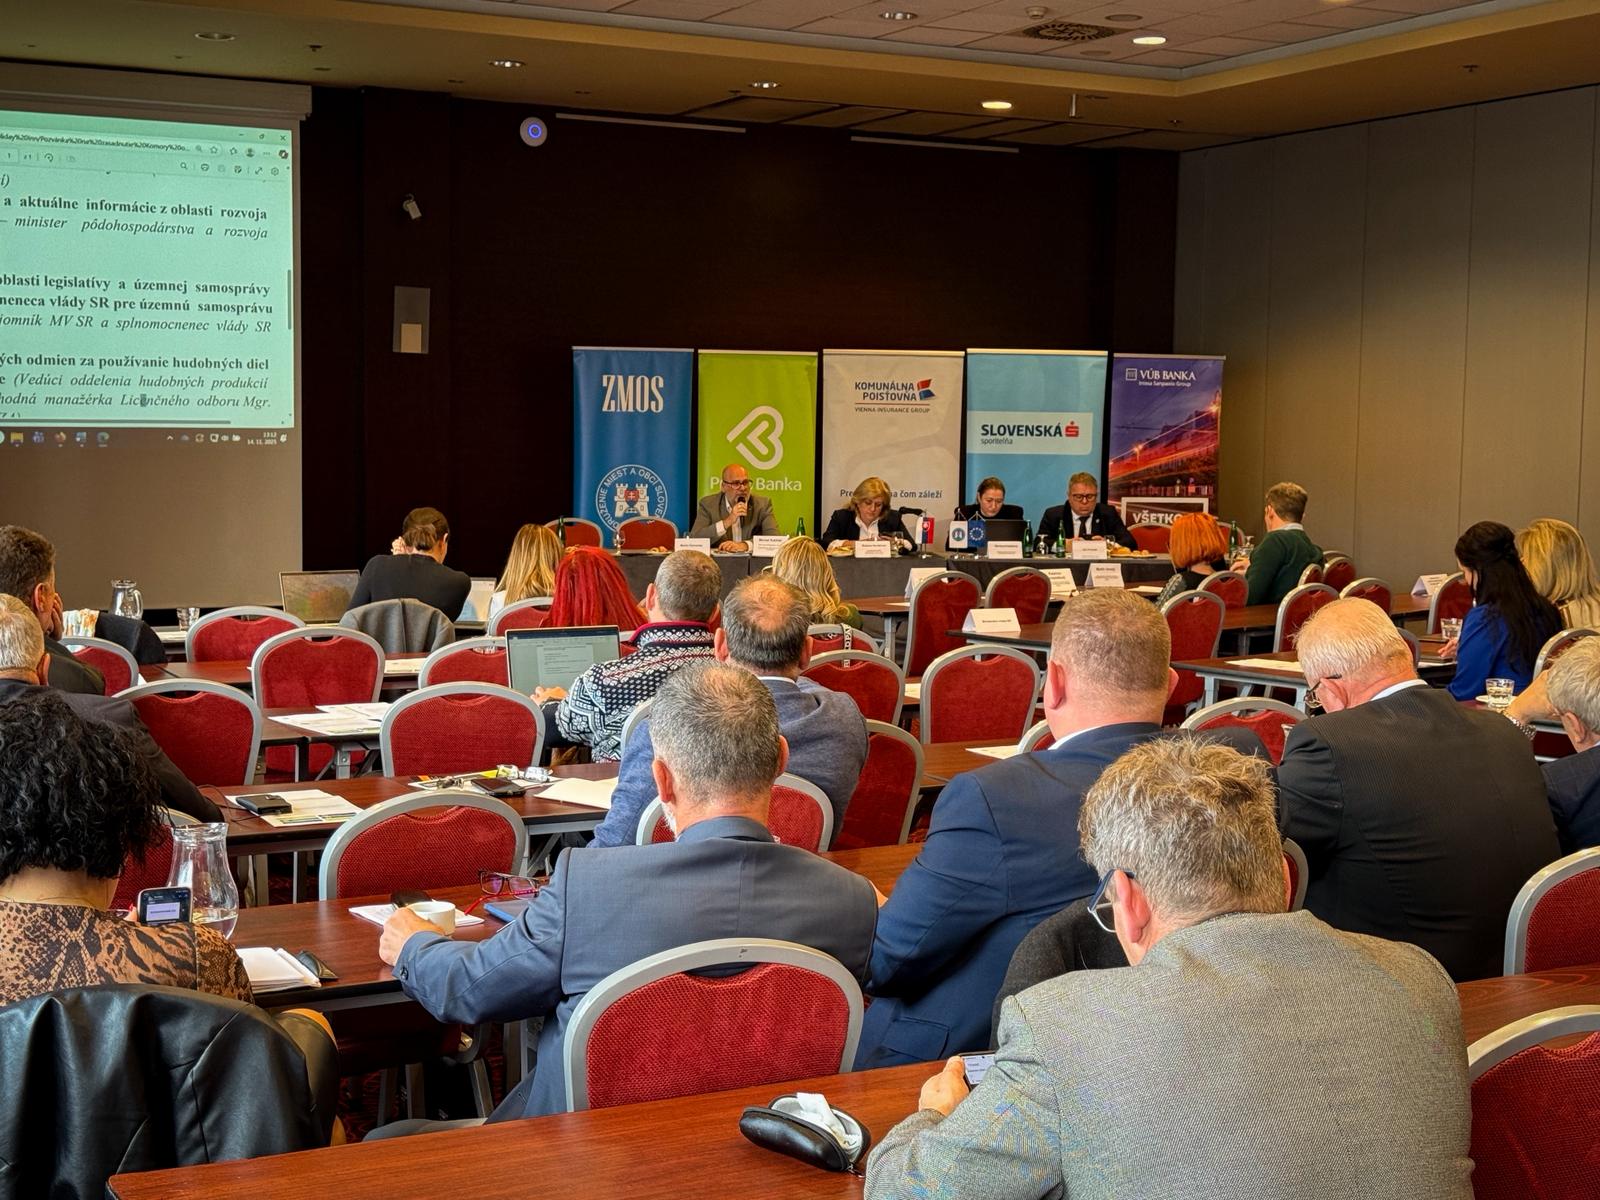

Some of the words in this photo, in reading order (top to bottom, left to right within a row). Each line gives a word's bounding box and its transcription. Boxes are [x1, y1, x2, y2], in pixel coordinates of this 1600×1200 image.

[20, 195, 79, 209] aktuálne
[86, 198, 157, 214] informácie
[160, 205, 168, 214] z
[171, 204, 213, 217] oblasti
[221, 208, 267, 222] rozvoja
[15, 216, 67, 229] minister
[81, 218, 195, 236] pôdohospodárstva
[205, 227, 214, 236] a
[224, 227, 268, 241] rozvoja
[44, 275, 111, 292] legislatívy
[119, 280, 126, 290] a
[134, 278, 187, 294] územnej
[195, 282, 271, 298] samosprávy
[50, 295, 86, 311] vlády
[90, 296, 110, 309] SR
[114, 301, 136, 312] pre
[140, 298, 190, 311] územnú
[198, 302, 273, 316] samosprávu
[50, 315, 73, 327] MV
[76, 315, 94, 328] SR
[101, 319, 109, 328] a
[116, 317, 210, 331] splnomocnenec
[217, 319, 249, 335] vlády
[255, 320, 272, 333] SR
[27, 354, 76, 366] odmien
[80, 357, 94, 367] za
[99, 355, 169, 369] používanie
[173, 356, 243, 372] hudobných
[246, 358, 270, 370] diel
[14, 373, 63, 388] (Vedúci
[70, 374, 131, 387] oddelenia
[139, 375, 205, 391] hudobných
[211, 376, 269, 391] produkcií
[1140, 368, 1161, 381] VÚB
[1162, 370, 1197, 381] BANKA
[602, 374, 664, 413] ZMOS
[854, 380, 915, 391] KOMUNÁLNA
[45, 393, 113, 406] manažérka
[197, 395, 241, 407] odboru
[243, 395, 272, 410] Mgr.
[862, 390, 918, 401] POISŤOVŇA
[981, 422, 1063, 438] SLOVENSKÁ
[603, 467, 628, 488] MIEST
[629, 467, 637, 476] A
[654, 484, 666, 519] SLOVE
[756, 477, 803, 492] Banka
[899, 489, 917, 498] čom
[918, 489, 943, 499] záleží
